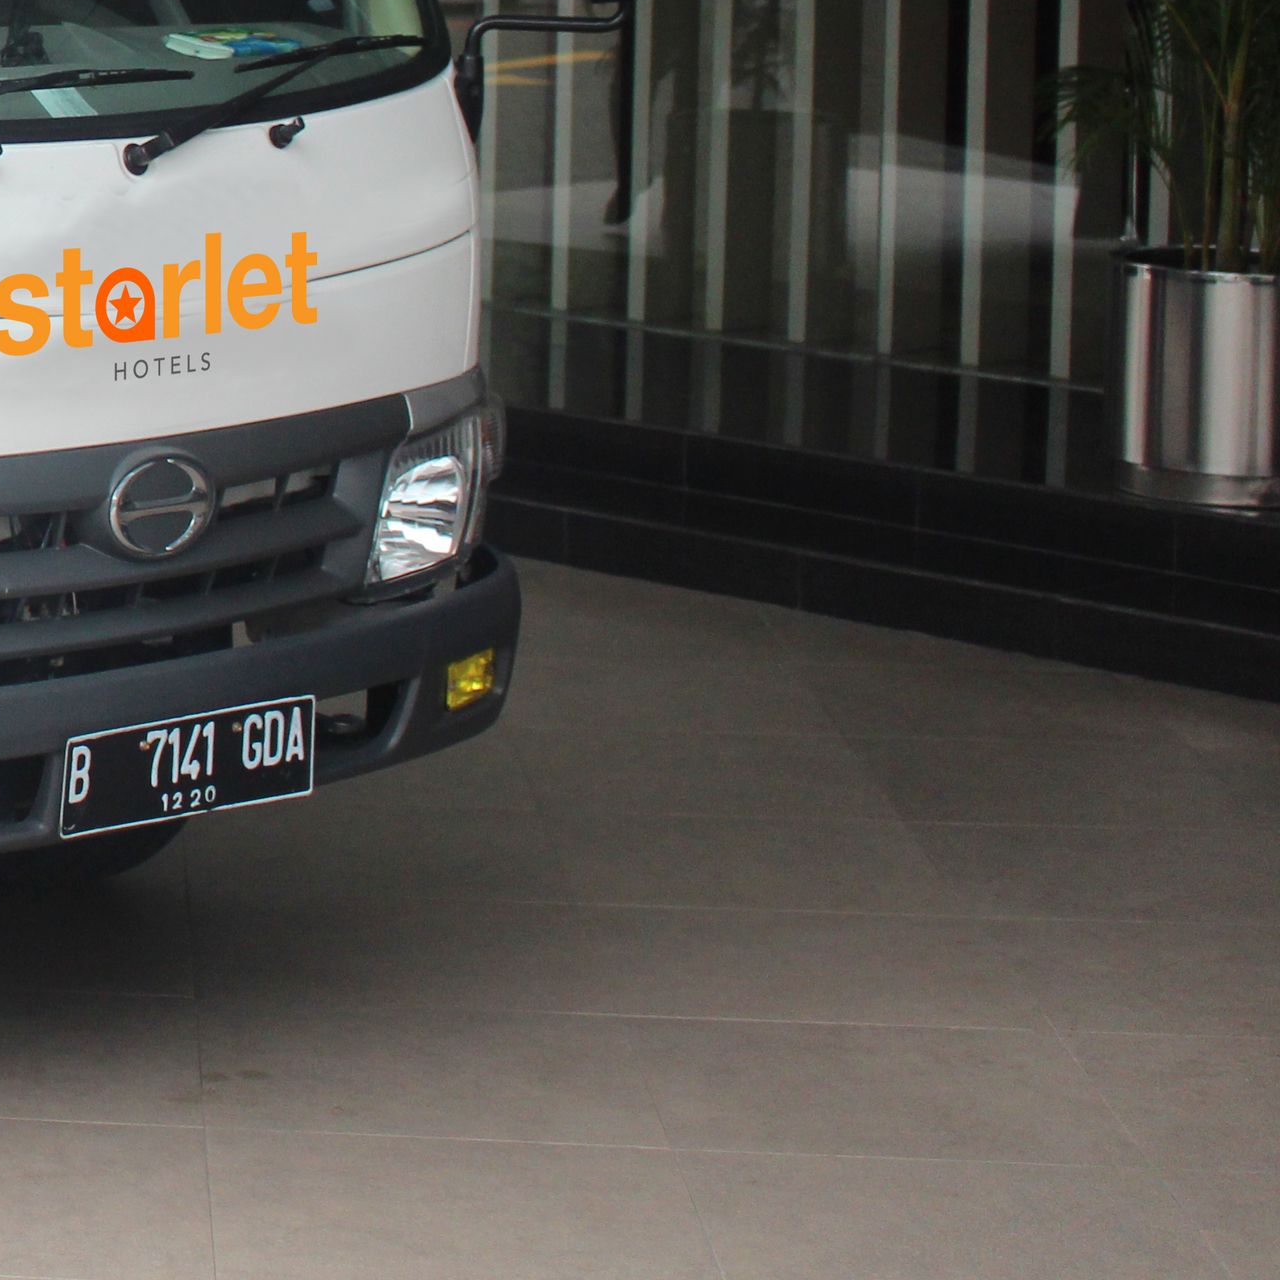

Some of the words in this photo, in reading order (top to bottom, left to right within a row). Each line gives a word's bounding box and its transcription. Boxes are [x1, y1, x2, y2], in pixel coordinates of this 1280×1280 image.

[113, 351, 212, 382] HOTELS
[68, 745, 92, 805] B
[146, 721, 216, 788] 7141
[242, 706, 305, 770] GDA
